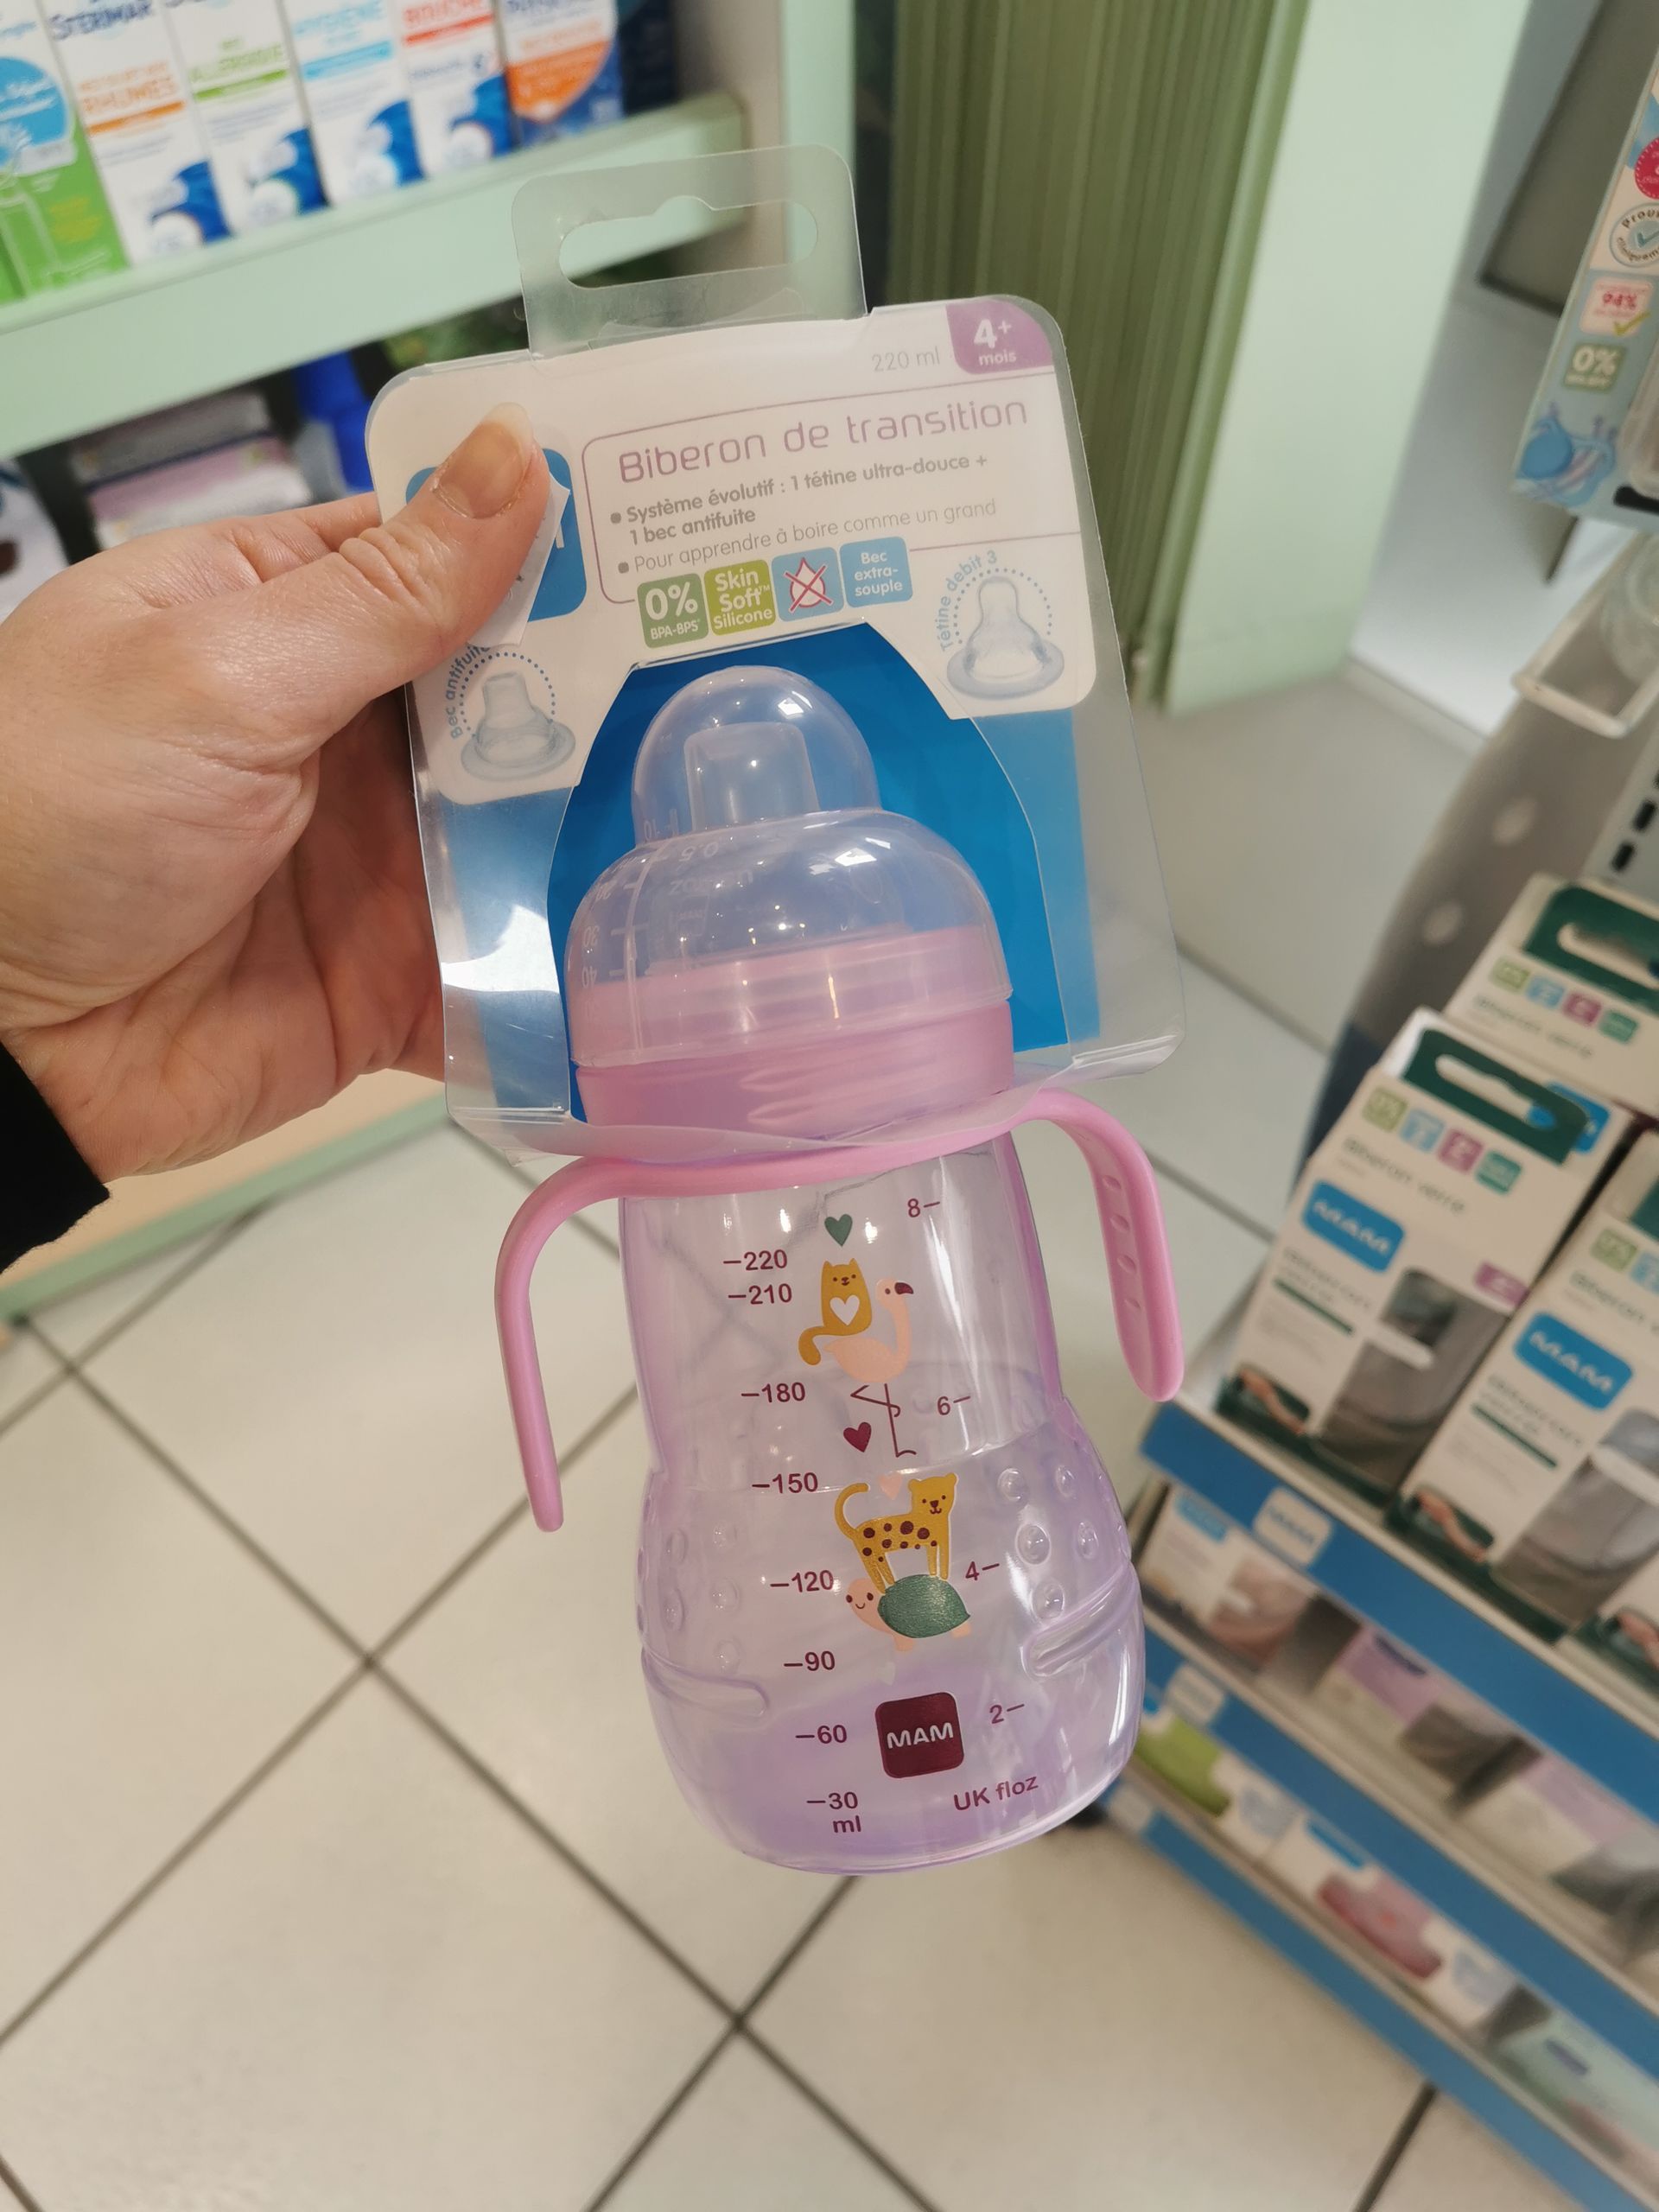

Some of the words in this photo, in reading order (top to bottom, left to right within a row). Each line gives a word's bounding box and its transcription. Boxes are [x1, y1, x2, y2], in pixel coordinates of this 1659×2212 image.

[871, 351, 910, 372] 220
[916, 346, 940, 366] ml
[978, 349, 1016, 366] mois
[1573, 346, 1618, 374] 0%
[619, 434, 766, 484] Biberon
[783, 421, 830, 453] de
[846, 401, 1027, 445] transition
[626, 497, 703, 524] Système
[708, 479, 774, 506] évolutif
[791, 475, 799, 491] 1
[804, 469, 857, 489] tétine
[862, 455, 970, 481] ultra-douce
[630, 530, 638, 546] 1
[643, 525, 677, 543] bec
[682, 508, 756, 535] antifuite
[634, 550, 673, 573] Pour
[679, 533, 771, 566] apprendre
[776, 528, 787, 544] à
[793, 522, 838, 542] boire
[844, 512, 911, 533] comme
[916, 508, 938, 524] un
[944, 498, 996, 524] grand
[861, 551, 887, 565] Bec
[987, 550, 997, 565] 3
[715, 569, 760, 593] Skin
[854, 567, 899, 582] extra-
[855, 579, 903, 597] souple
[645, 582, 698, 620] 0%
[714, 608, 772, 630] Silicone
[446, 706, 463, 739] Bec
[908, 1198, 920, 1217] 8
[743, 1249, 787, 1271] 220
[750, 1283, 792, 1305] 210
[762, 1382, 805, 1403] 180
[938, 1396, 950, 1415] 6
[772, 1471, 818, 1494] 150
[791, 1570, 834, 1592] 120
[965, 1561, 980, 1581] 4
[805, 1650, 836, 1671] 90
[989, 1705, 1004, 1724] 2
[817, 1725, 847, 1744] 60
[887, 1722, 954, 1750] MAM
[829, 1791, 858, 1809] 30
[953, 1787, 990, 1811] UK
[833, 1815, 861, 1834] ml
